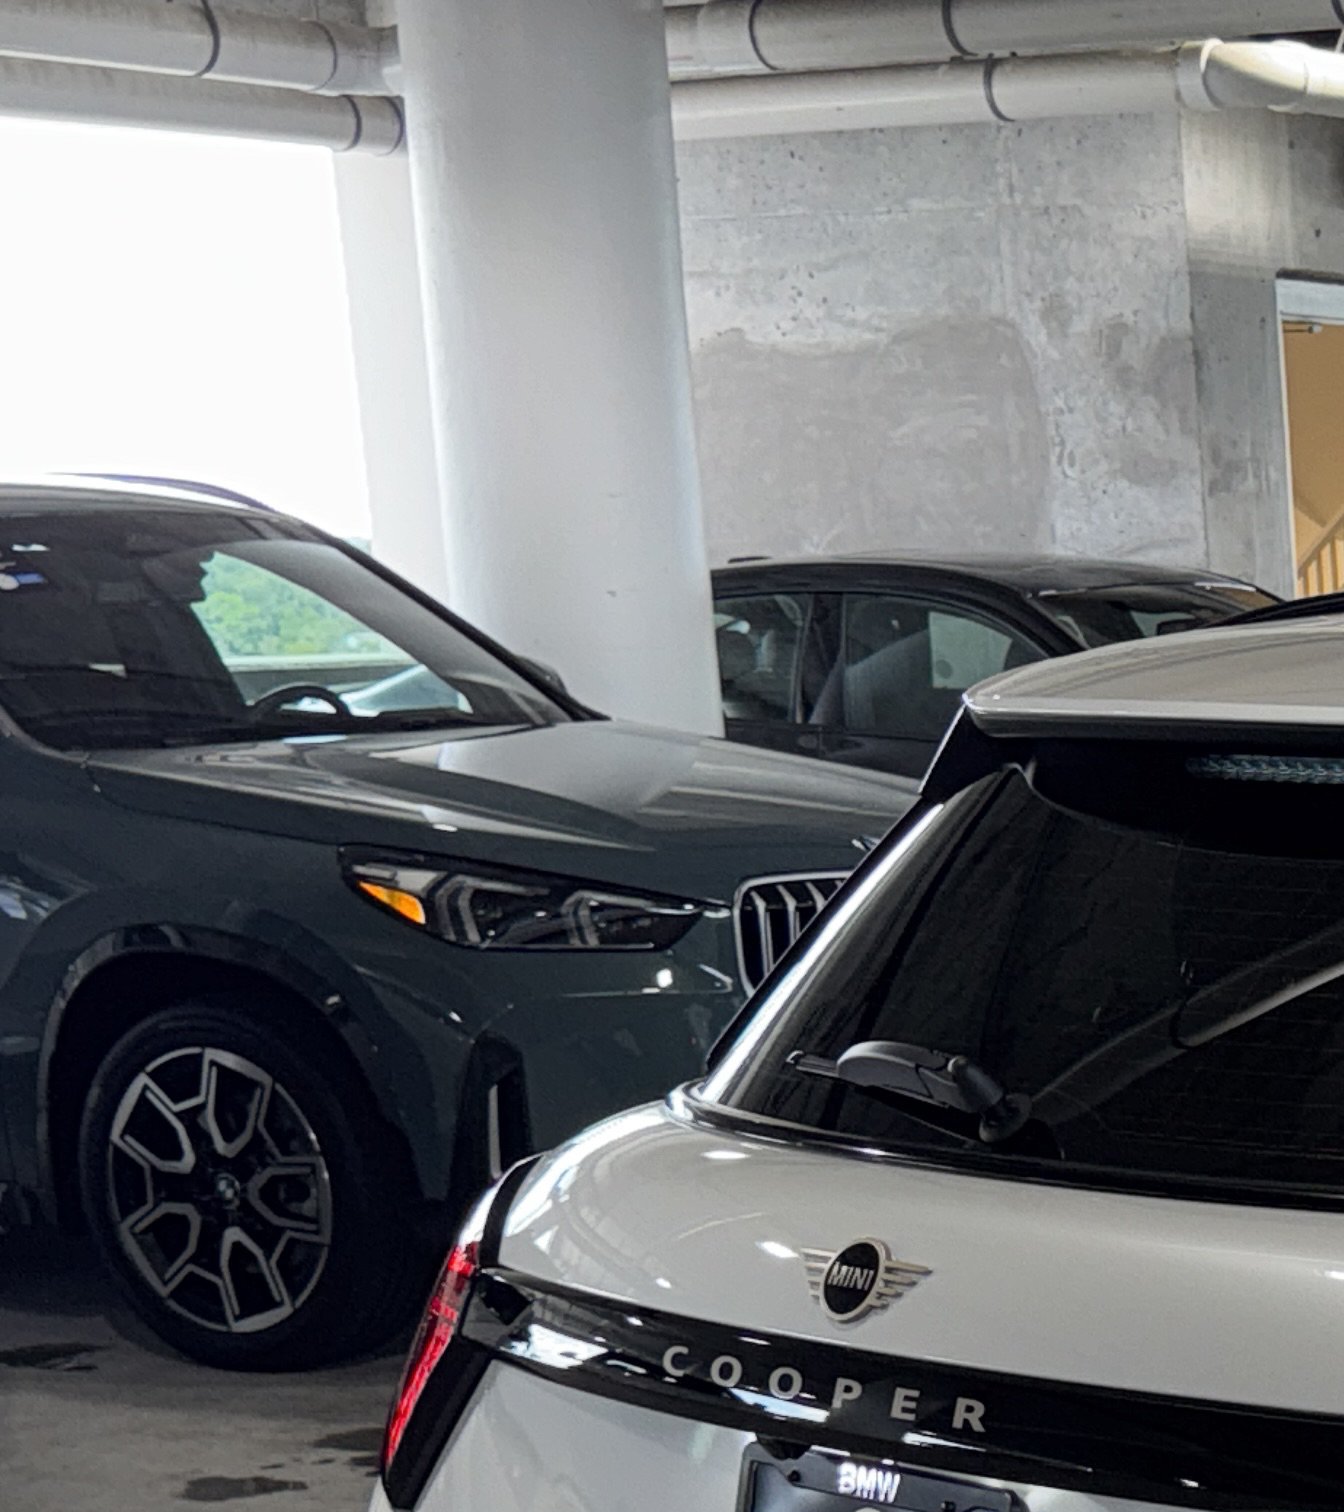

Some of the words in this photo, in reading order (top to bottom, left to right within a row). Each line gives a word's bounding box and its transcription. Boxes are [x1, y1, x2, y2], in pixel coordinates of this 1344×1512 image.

[827, 1260, 875, 1292] MINI
[662, 1344, 987, 1433] COOPER
[838, 1461, 901, 1503] BMW
